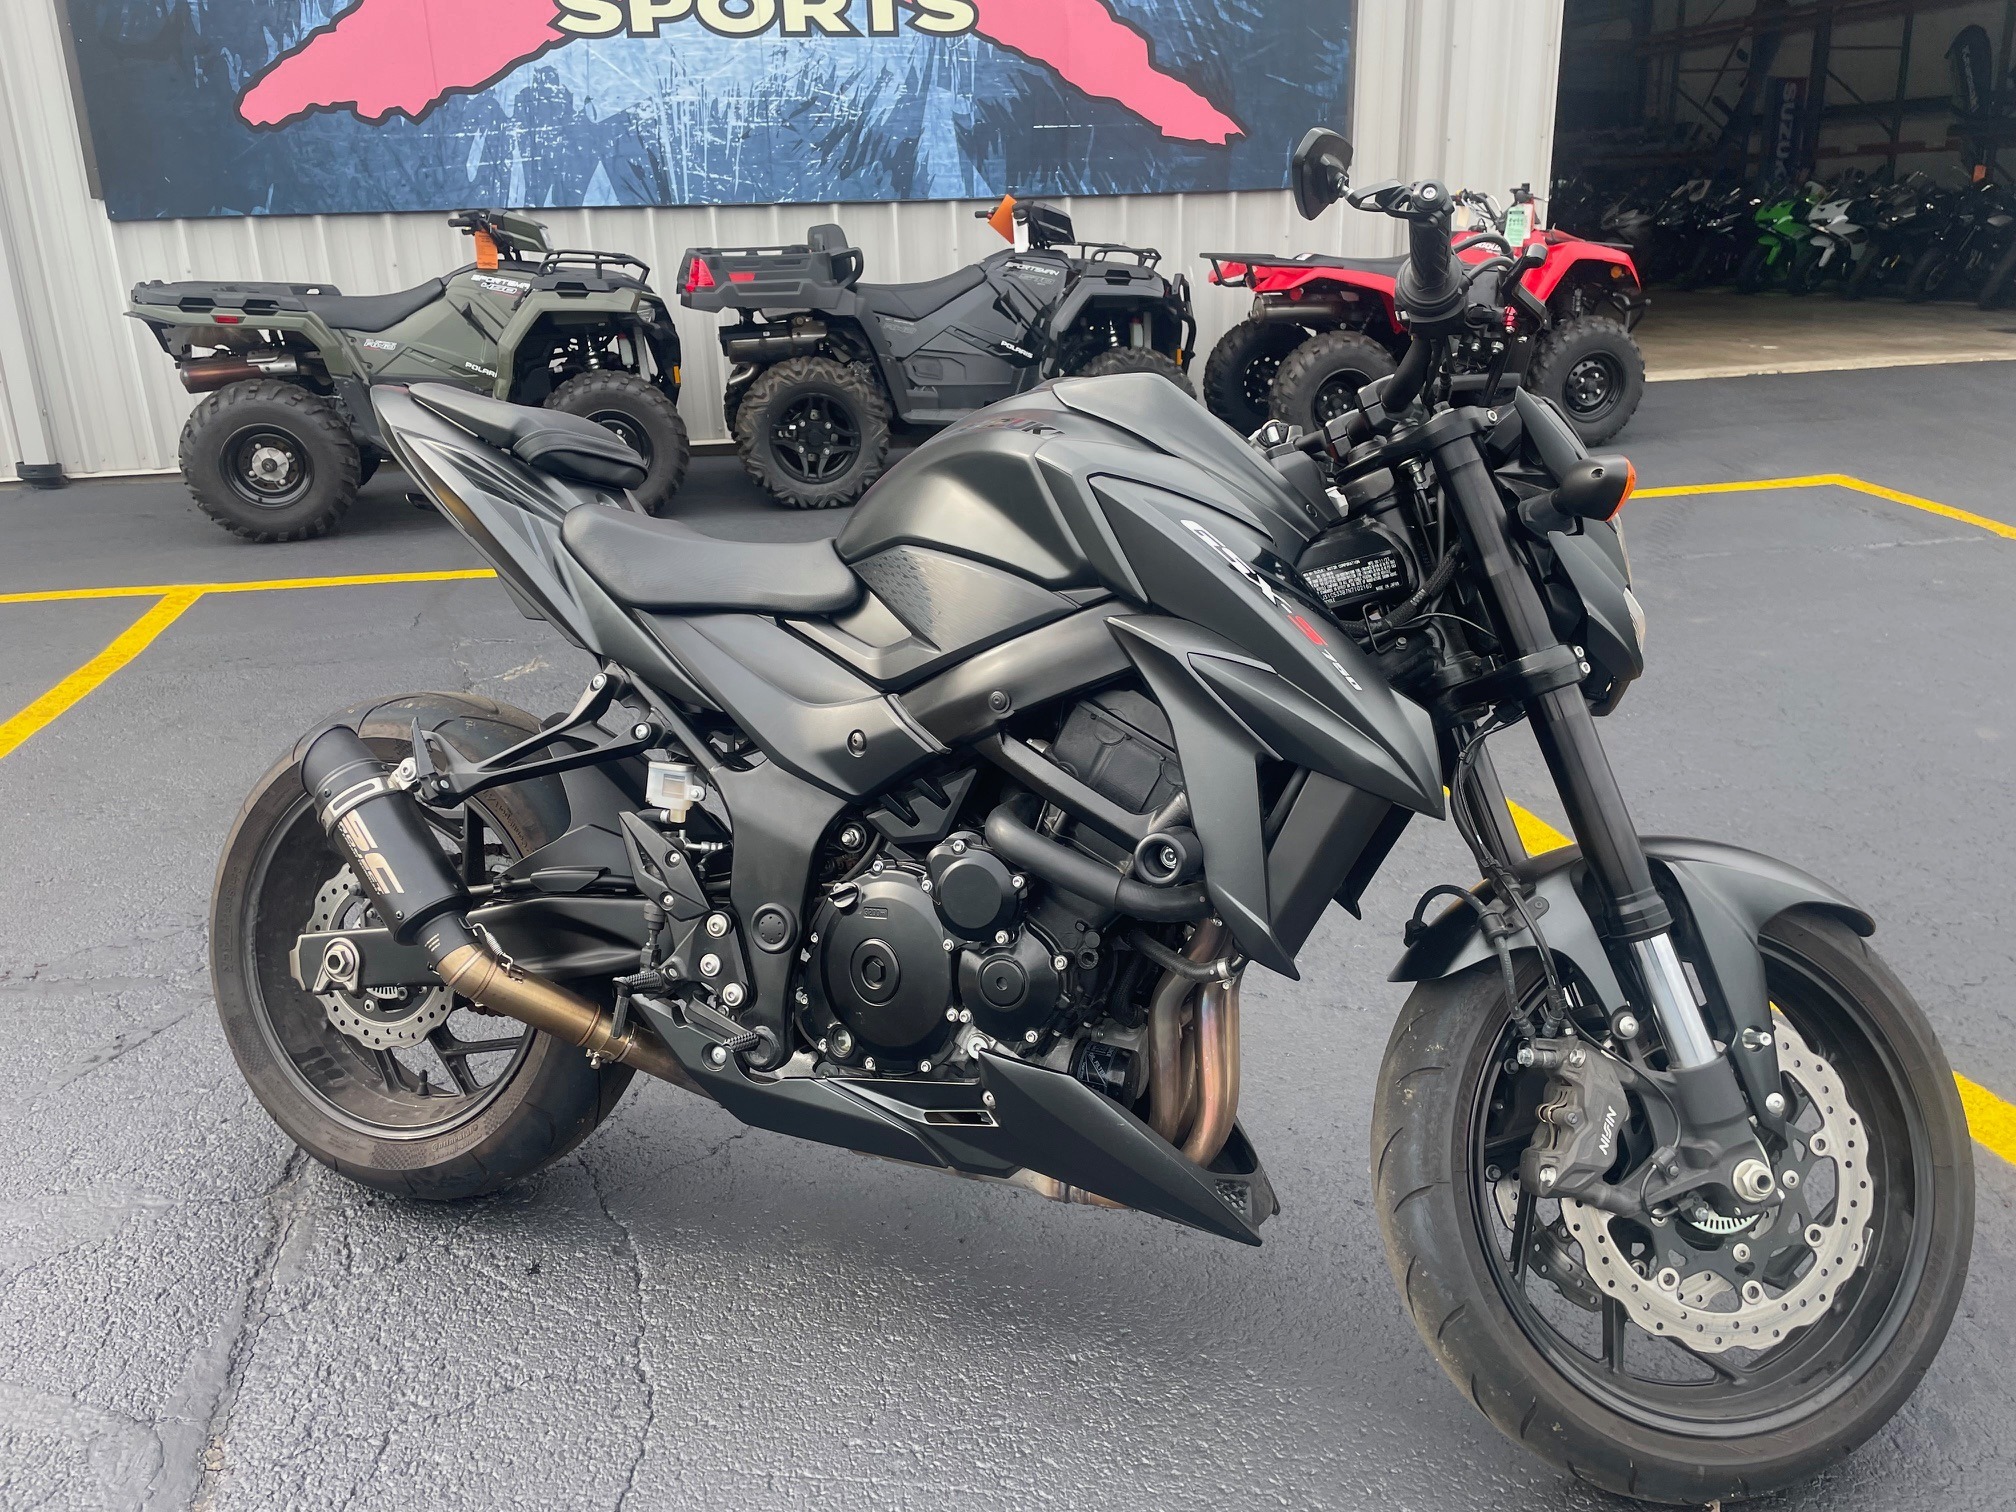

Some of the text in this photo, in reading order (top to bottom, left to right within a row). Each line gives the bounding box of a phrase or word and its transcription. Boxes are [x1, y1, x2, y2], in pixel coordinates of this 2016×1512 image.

[556, 0, 976, 36] SPORTS
[1775, 82, 1797, 180] SUZUK
[1001, 340, 1034, 359] POLARIS
[465, 361, 498, 378] POLARI
[1322, 649, 1362, 691] 750
[1599, 1105, 1618, 1156] NISSIN
